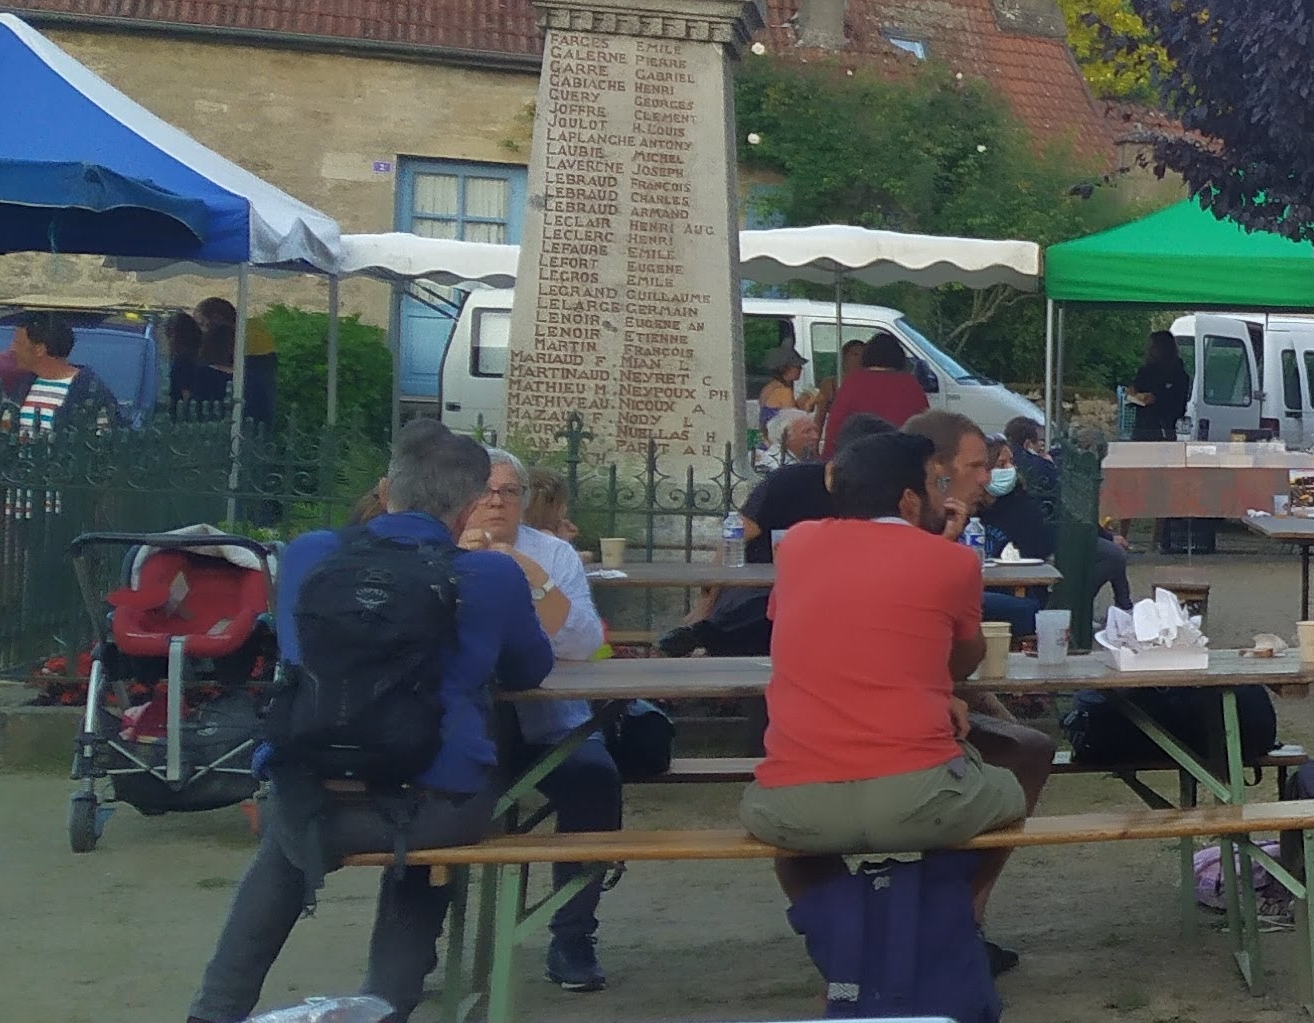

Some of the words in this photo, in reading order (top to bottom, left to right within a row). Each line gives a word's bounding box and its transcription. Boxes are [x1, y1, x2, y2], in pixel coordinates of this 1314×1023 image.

[637, 42, 681, 55] EMILE
[551, 47, 626, 64] GALERNE
[636, 55, 686, 69] PIERRE
[550, 61, 608, 77] GARRE
[635, 69, 695, 84] GABRIEL
[549, 89, 600, 103] GUERY
[635, 82, 674, 95] HENRI
[549, 102, 606, 117] JOFFRE
[634, 110, 697, 124] CLEMENT
[548, 116, 608, 130] JOULOT
[547, 129, 636, 147] LAPLANCHE
[547, 143, 604, 159] LAUBIE
[631, 151, 684, 164] MICHEL
[632, 164, 684, 177] JOSEPH
[546, 172, 618, 188] LEBRAUD
[545, 186, 618, 202] LEBRAUD
[631, 192, 690, 207] CHARLES
[544, 199, 618, 215] LEBRAUD
[631, 207, 689, 219] ARMAND
[544, 214, 611, 229] LECLAIR
[630, 220, 674, 233] HENRI
[543, 227, 614, 243] LECLERC
[628, 234, 673, 246] HENRI
[542, 240, 608, 256] LEFAURE
[627, 247, 676, 260] EMILE
[539, 254, 598, 269] LEFORT
[627, 262, 683, 274] EUGENE
[627, 275, 674, 288] EMILE
[626, 290, 711, 304] GUILLAUME
[626, 303, 698, 317] GERMAIN
[536, 312, 600, 326] LENOIR
[625, 317, 680, 330] EUGENE
[535, 324, 600, 339] LENOIR
[625, 331, 688, 344] ETIENNE
[535, 337, 597, 352] MARTIN
[511, 350, 584, 366] MARIAUD
[620, 357, 661, 369] MIAN
[620, 370, 689, 385] NEYRET
[509, 378, 585, 393] MATHIEU
[619, 398, 676, 412] NICOUX
[618, 411, 662, 425] NODY
[615, 439, 670, 454] PART
